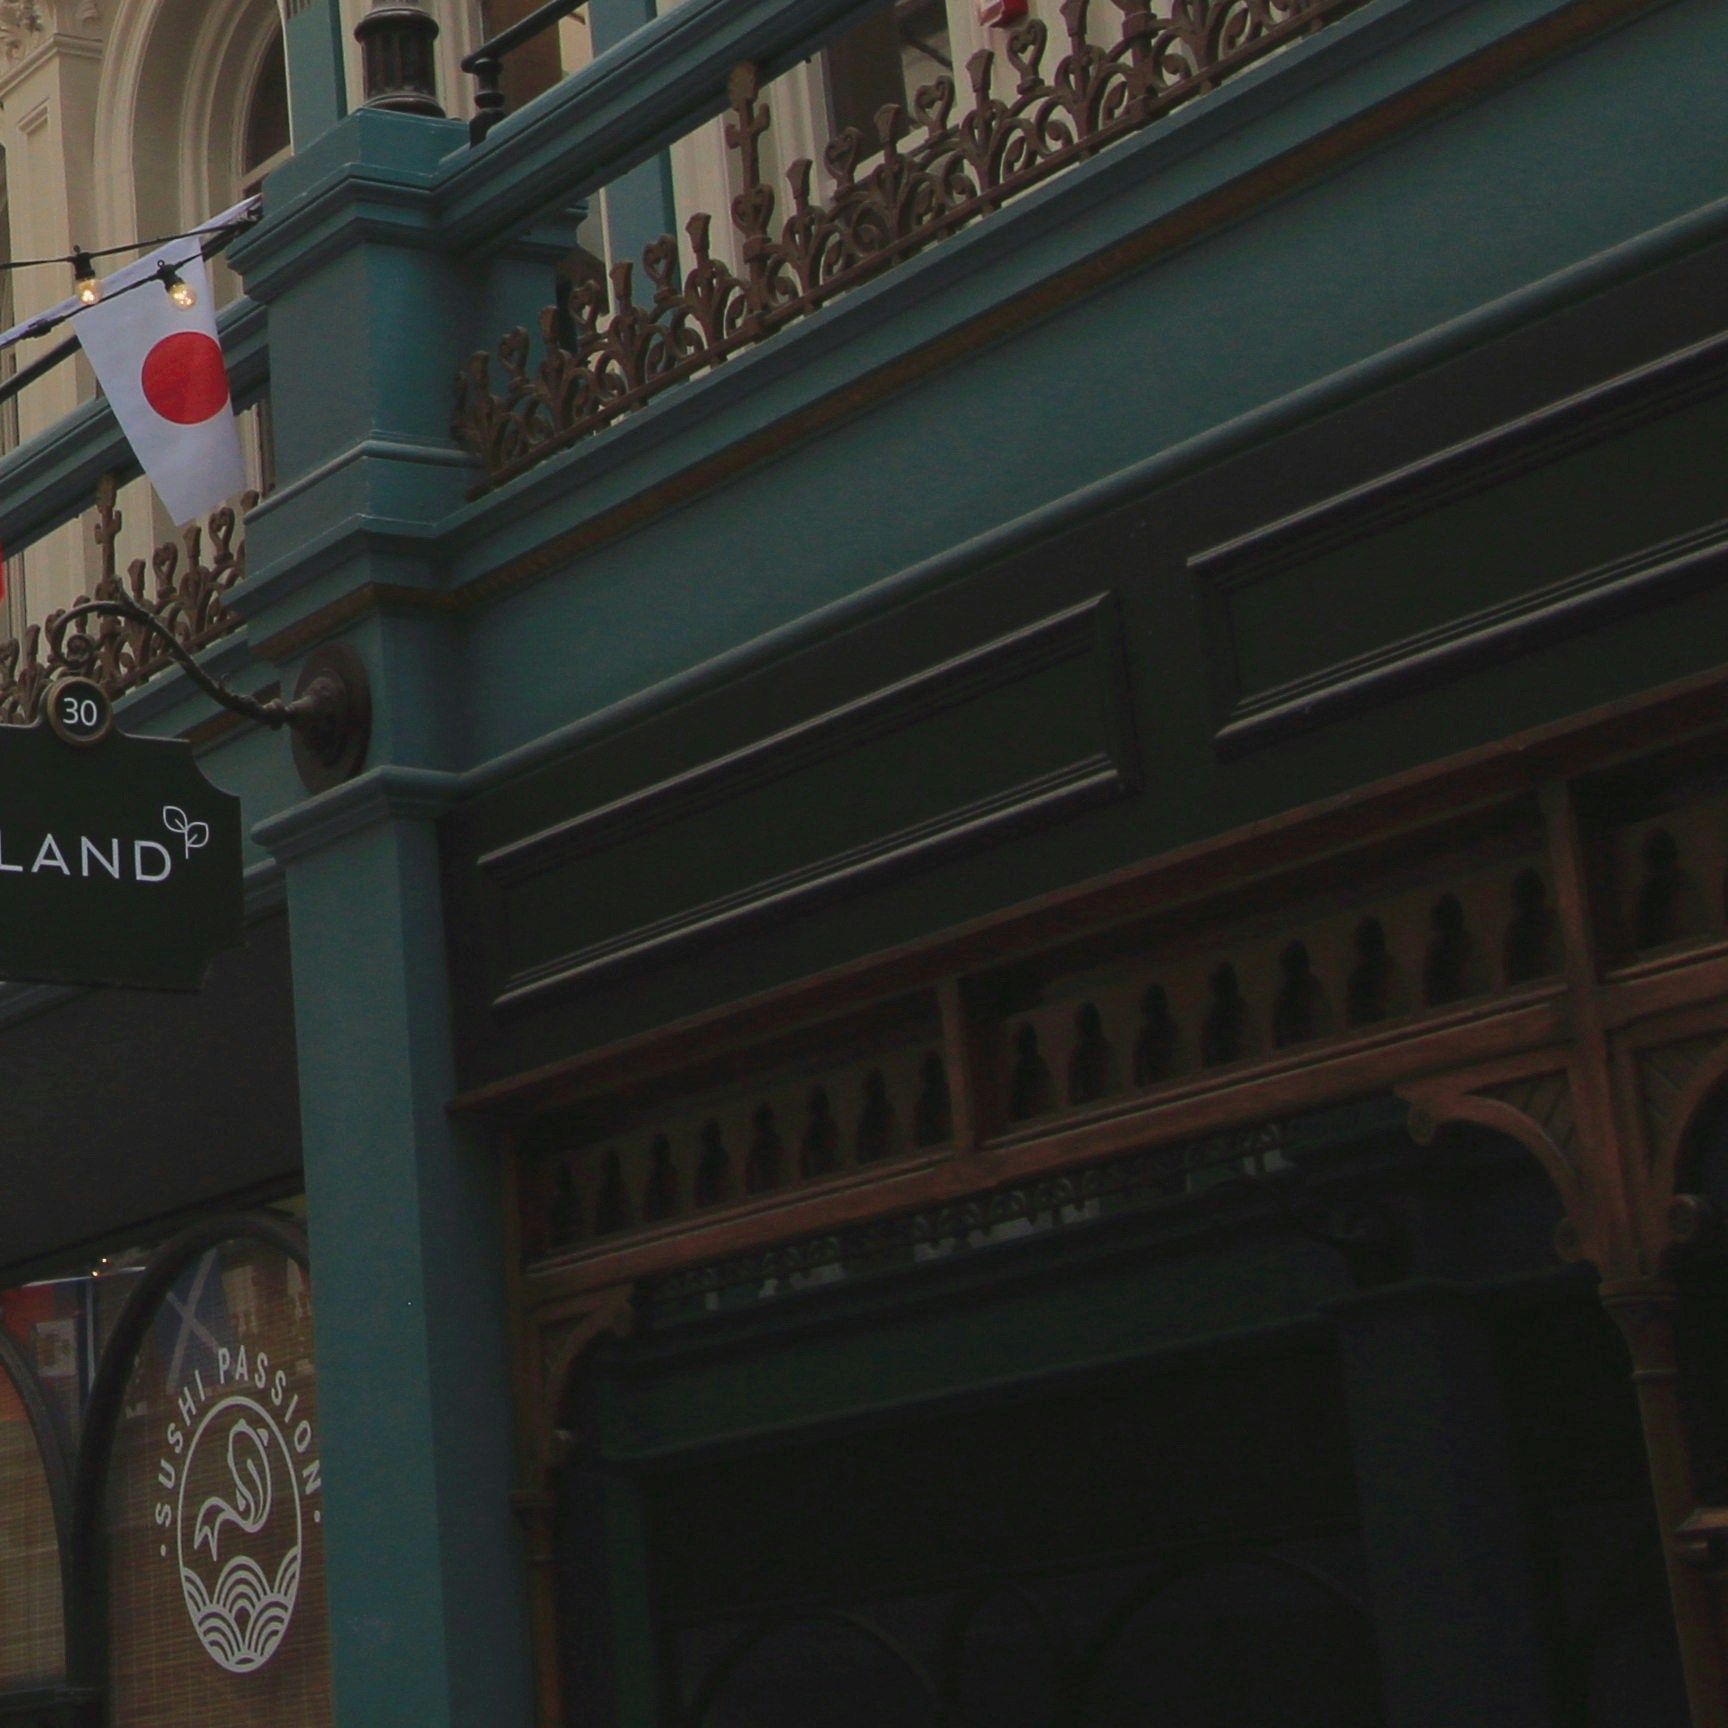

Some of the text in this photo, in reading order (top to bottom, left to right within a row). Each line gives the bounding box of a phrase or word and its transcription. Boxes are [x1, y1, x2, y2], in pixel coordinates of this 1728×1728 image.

[62, 697, 98, 727] 30
[155, 1344, 322, 1528] SUSHI PASSION
